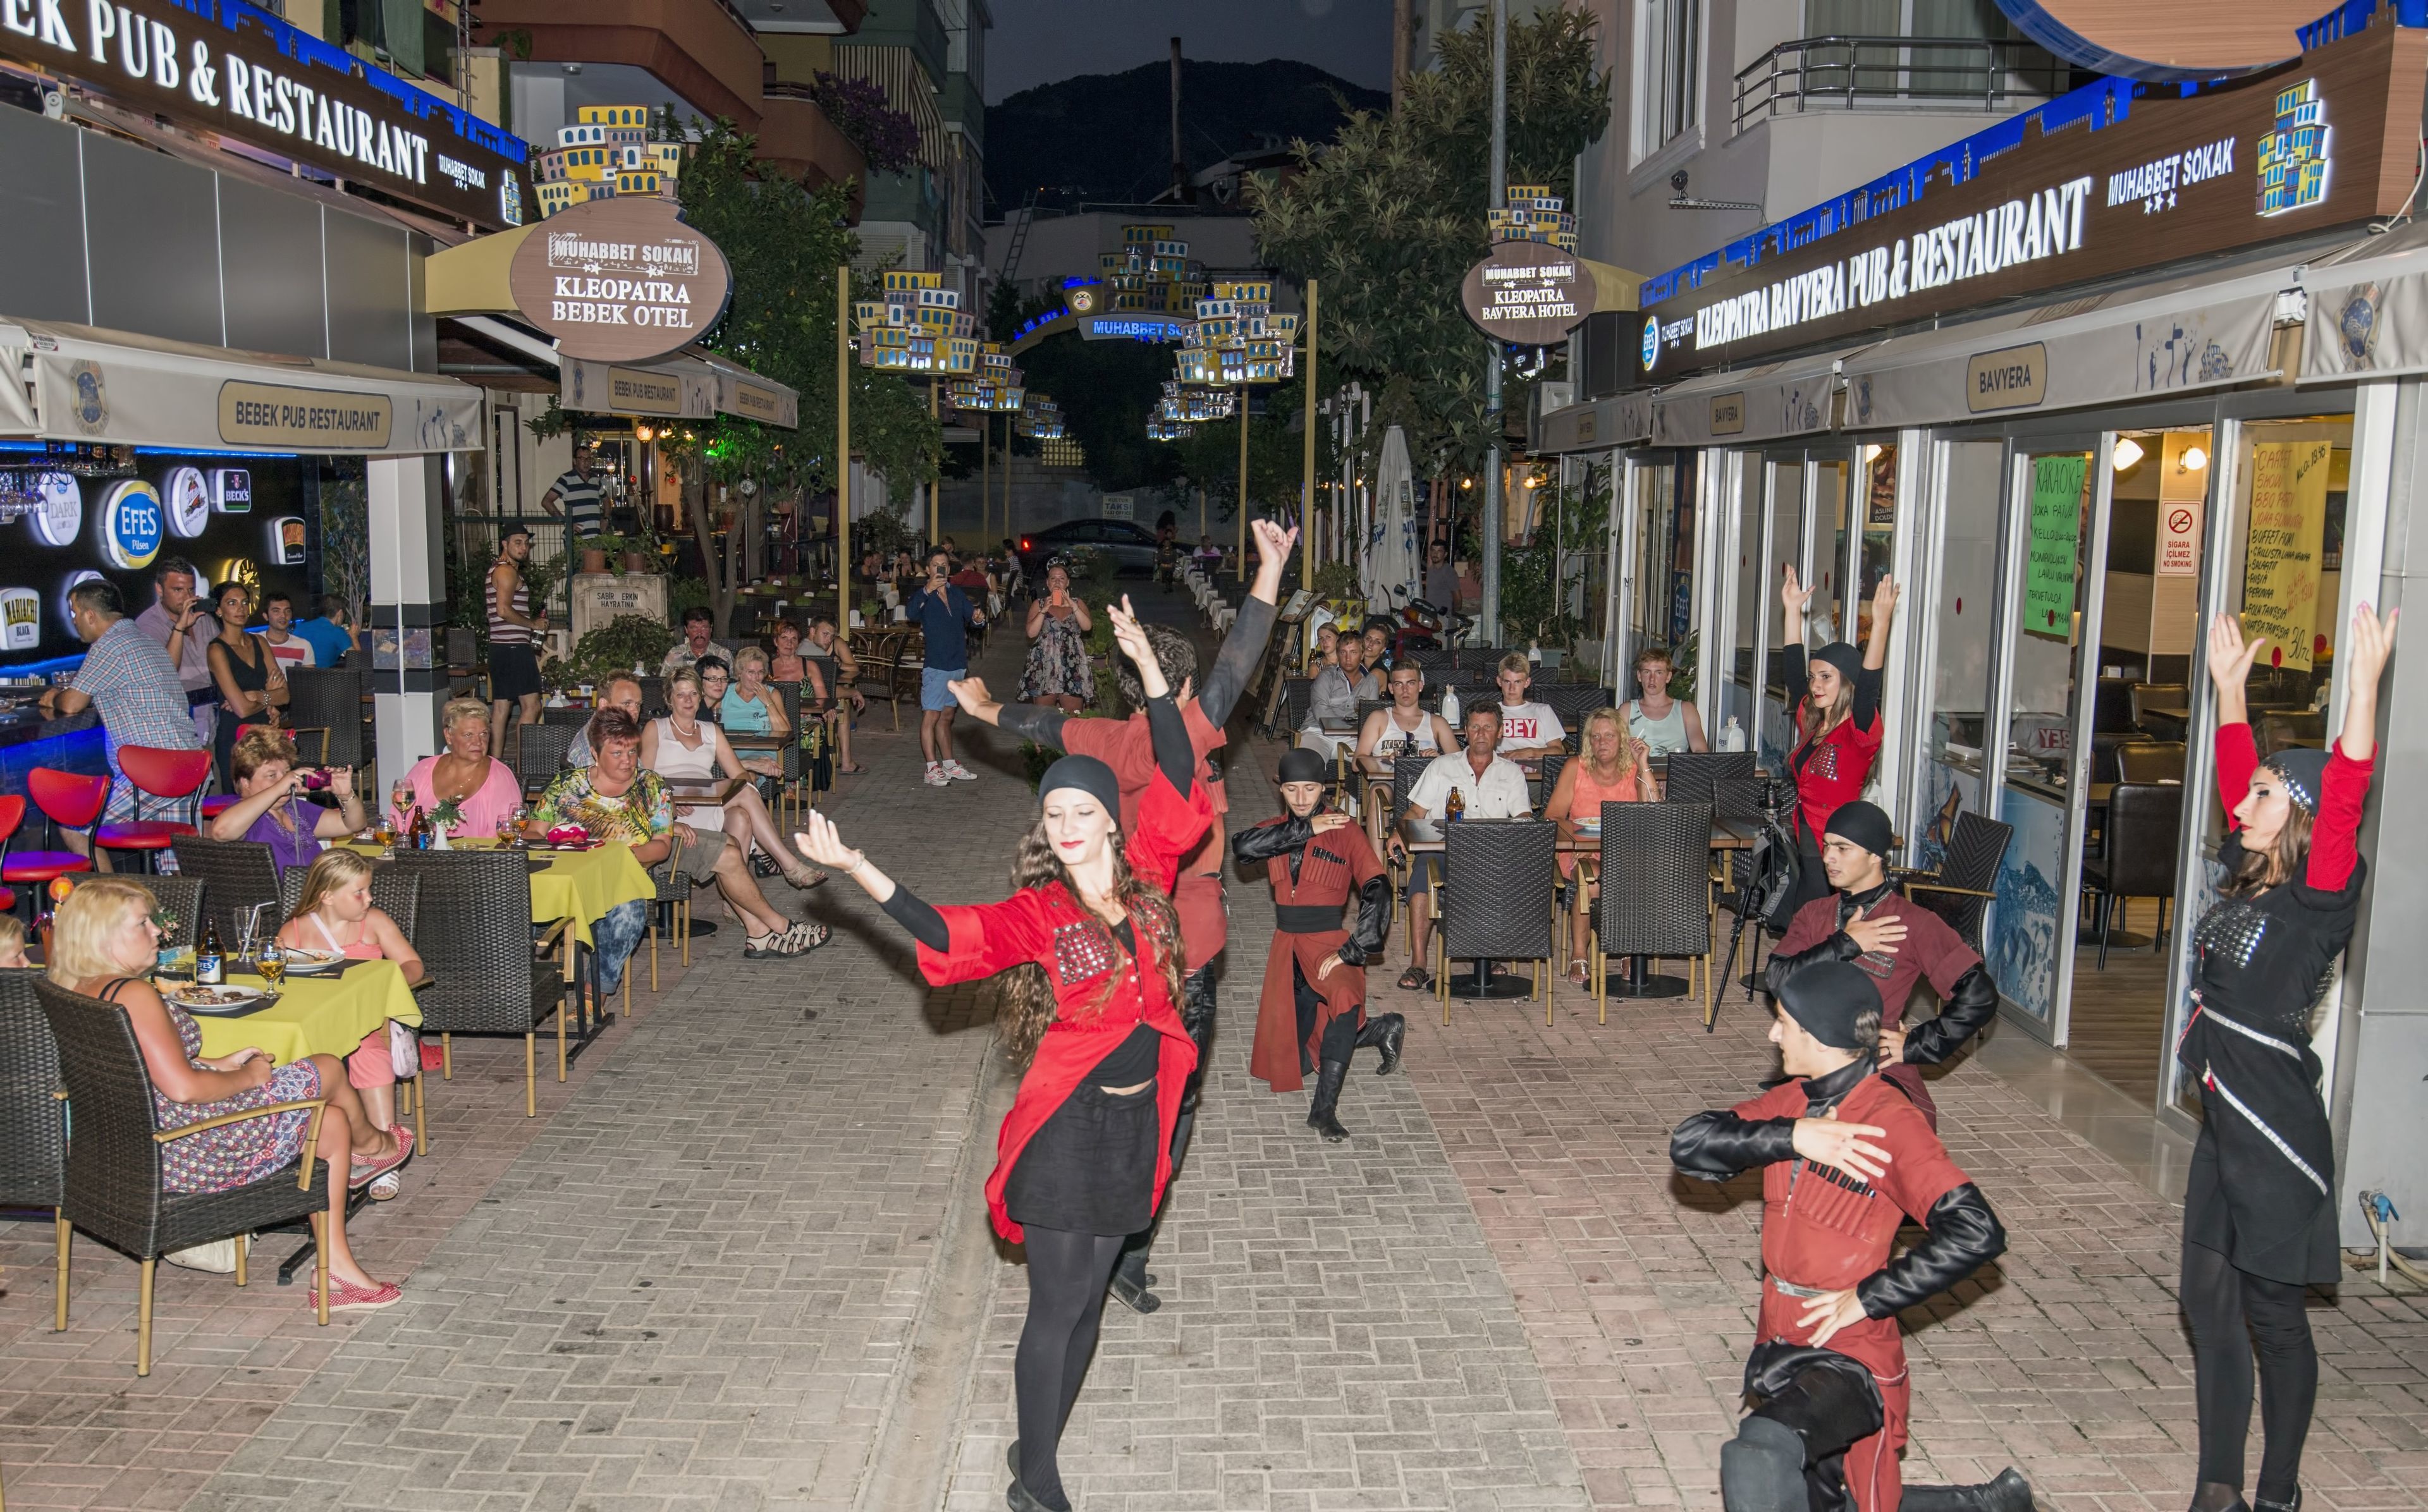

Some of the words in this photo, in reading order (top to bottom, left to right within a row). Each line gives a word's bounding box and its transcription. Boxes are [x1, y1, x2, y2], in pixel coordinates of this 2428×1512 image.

[89, 0, 180, 88] PUB
[190, 40, 220, 106] &
[226, 53, 428, 185] RESTAURANT
[439, 154, 467, 182] MUHABBET
[468, 166, 486, 190] SOKAK
[2107, 154, 2181, 207] MUHABBET
[2182, 136, 2235, 186] SOKAK
[555, 240, 637, 260] MUHABBET
[642, 245, 693, 264] SOKAK
[1695, 286, 1769, 350] KLEOPATRA
[1770, 260, 1846, 331] BAVYERA
[1846, 246, 1889, 310] PUB
[1889, 239, 1908, 300] &
[1908, 176, 2091, 293] RESTAURANT
[1485, 267, 1537, 280] MUHABBET
[1540, 265, 1572, 278] SOKAK
[555, 276, 691, 303] KLEOPATRA
[1494, 288, 1565, 304] KLEOPATRA
[552, 301, 628, 325] BEBEK
[634, 306, 694, 328] OTEL
[1482, 305, 1538, 320] BAVYERA
[1538, 303, 1578, 317] HOTEL
[1094, 321, 1165, 336] MUHABBET
[1979, 363, 2032, 394] BAVYERA
[615, 380, 632, 397] BEBEK
[633, 383, 644, 398] PUB
[644, 384, 676, 401] RESTAURANT
[236, 401, 279, 427] BEBEK
[282, 405, 305, 429] PUB
[310, 408, 381, 432] RESTAURANT
[1715, 406, 1738, 424] BAVYERA
[2035, 459, 2082, 496] KARAOKE
[2257, 473, 2283, 489] SHOW
[225, 488, 249, 502] BECK'S
[50, 501, 77, 518] DARK
[2033, 504, 2049, 516] JOKA
[121, 506, 157, 536] EFES
[2033, 527, 2055, 540] KELLO
[2251, 529, 2281, 545] BUFFET
[132, 539, 150, 551] Pilsen
[2167, 540, 2190, 549] SİGARA
[2166, 550, 2190, 559] İÇİLMEZ
[601, 601, 635, 609] HAYRATINA
[2028, 589, 2062, 604] TERVETULOA
[4, 598, 38, 627] MARIACHI
[1675, 594, 1689, 620] EFES
[16, 625, 30, 637] BLACK
[197, 960, 213, 969] EFES
